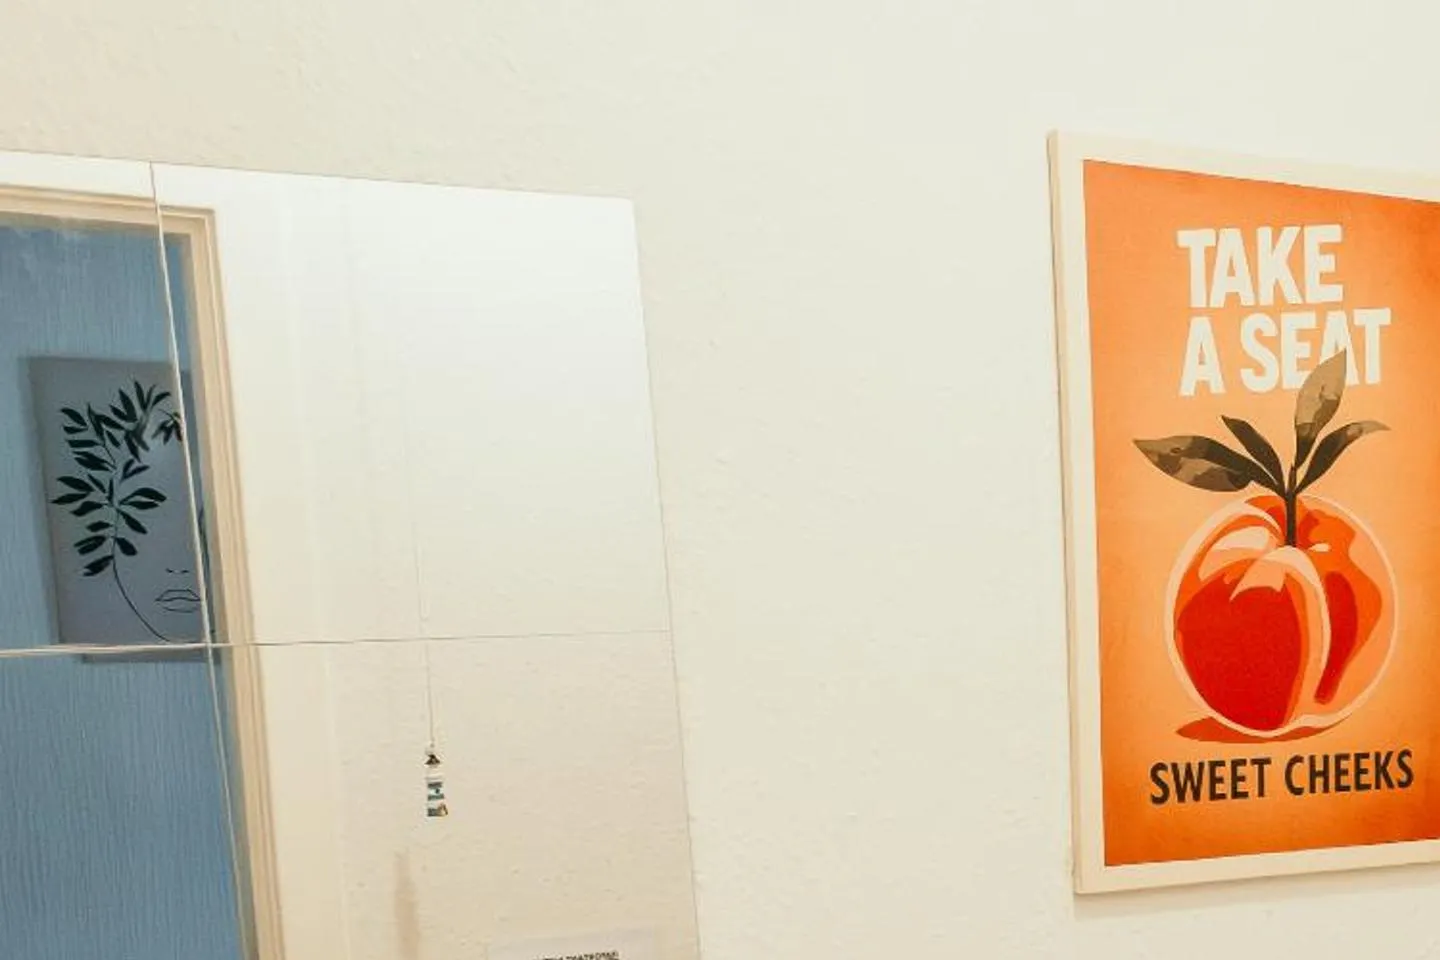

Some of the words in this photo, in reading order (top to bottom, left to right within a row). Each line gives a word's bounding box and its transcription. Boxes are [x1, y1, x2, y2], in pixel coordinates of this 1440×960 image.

[1177, 223, 1344, 308] TAKE
[1180, 313, 1226, 397] A
[1240, 307, 1392, 394] SEAT
[1149, 757, 1273, 805] SWEET
[1283, 748, 1415, 796] CHEEKS
